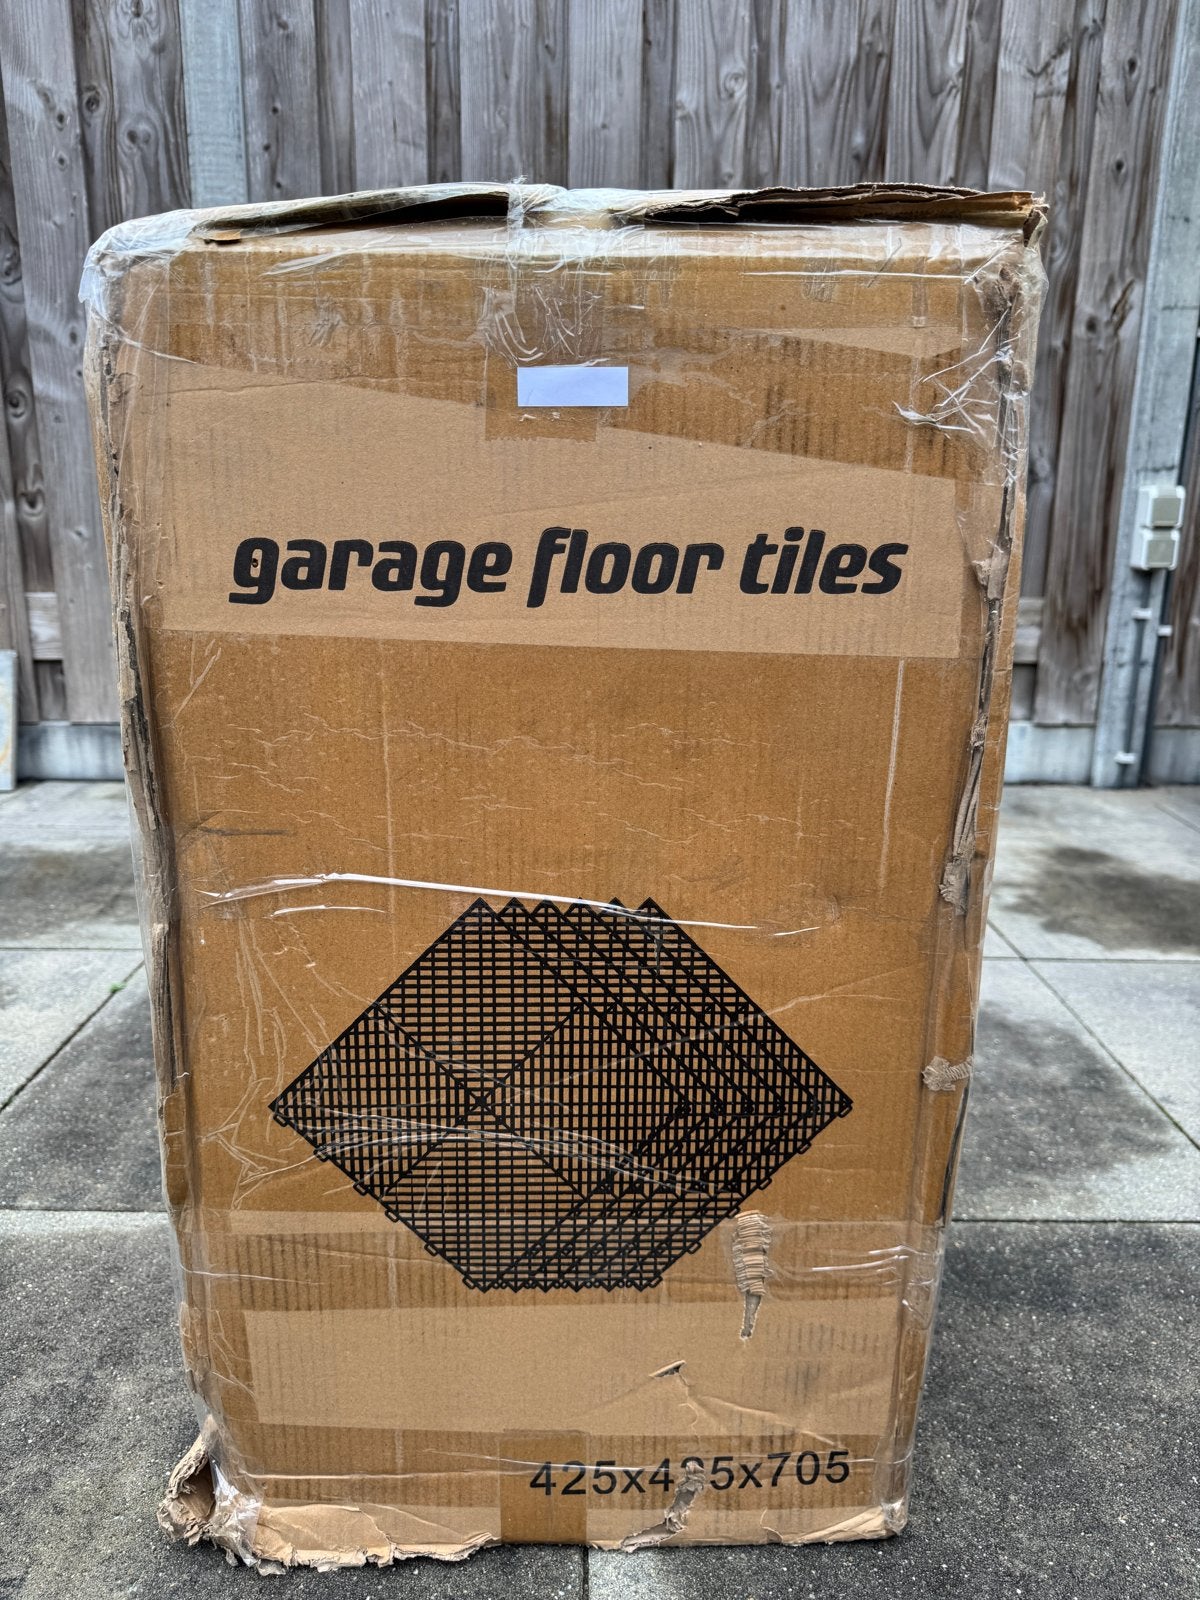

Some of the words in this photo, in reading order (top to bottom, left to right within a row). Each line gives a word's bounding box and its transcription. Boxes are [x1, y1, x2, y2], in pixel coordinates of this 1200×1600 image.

[228, 537, 513, 606] garage
[526, 525, 725, 608] floor
[739, 525, 909, 596] tiles
